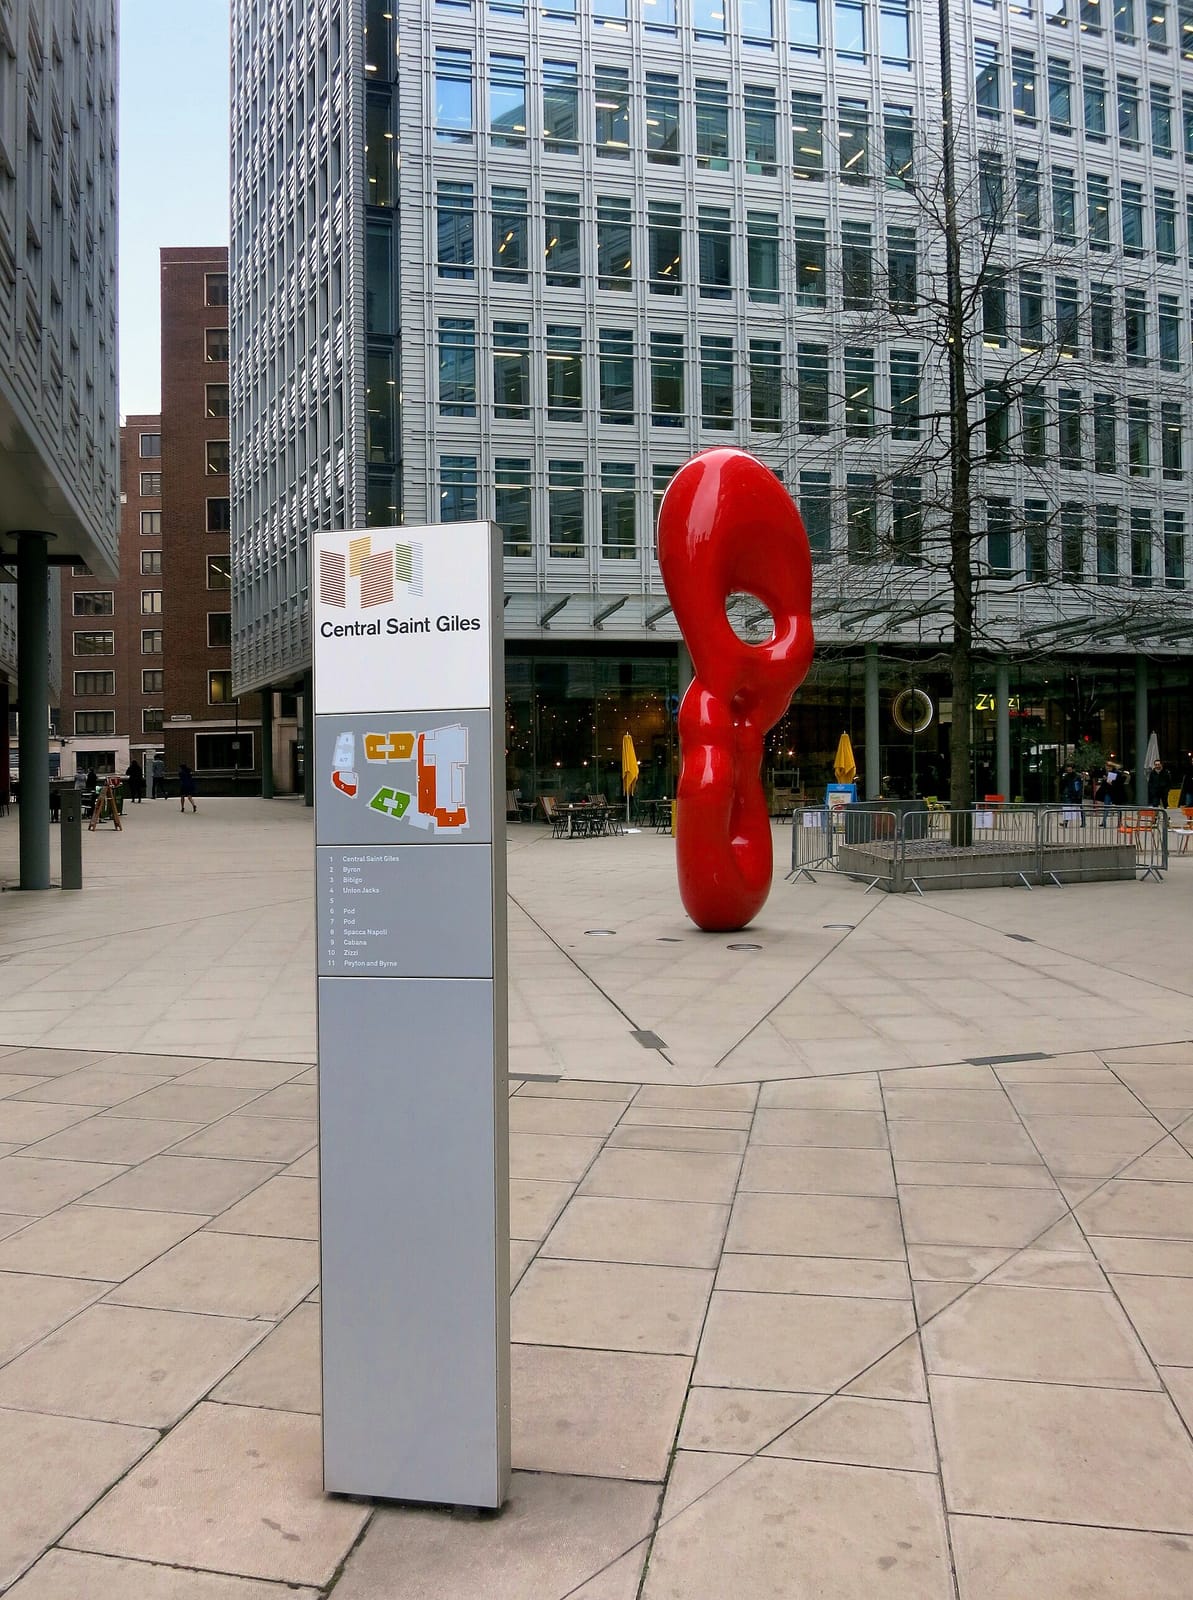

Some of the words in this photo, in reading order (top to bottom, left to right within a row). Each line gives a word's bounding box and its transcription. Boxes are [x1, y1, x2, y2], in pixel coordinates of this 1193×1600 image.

[320, 619, 380, 637] Central
[386, 618, 430, 634] Saint
[436, 615, 480, 632] Giles
[974, 694, 1020, 710] Zizi
